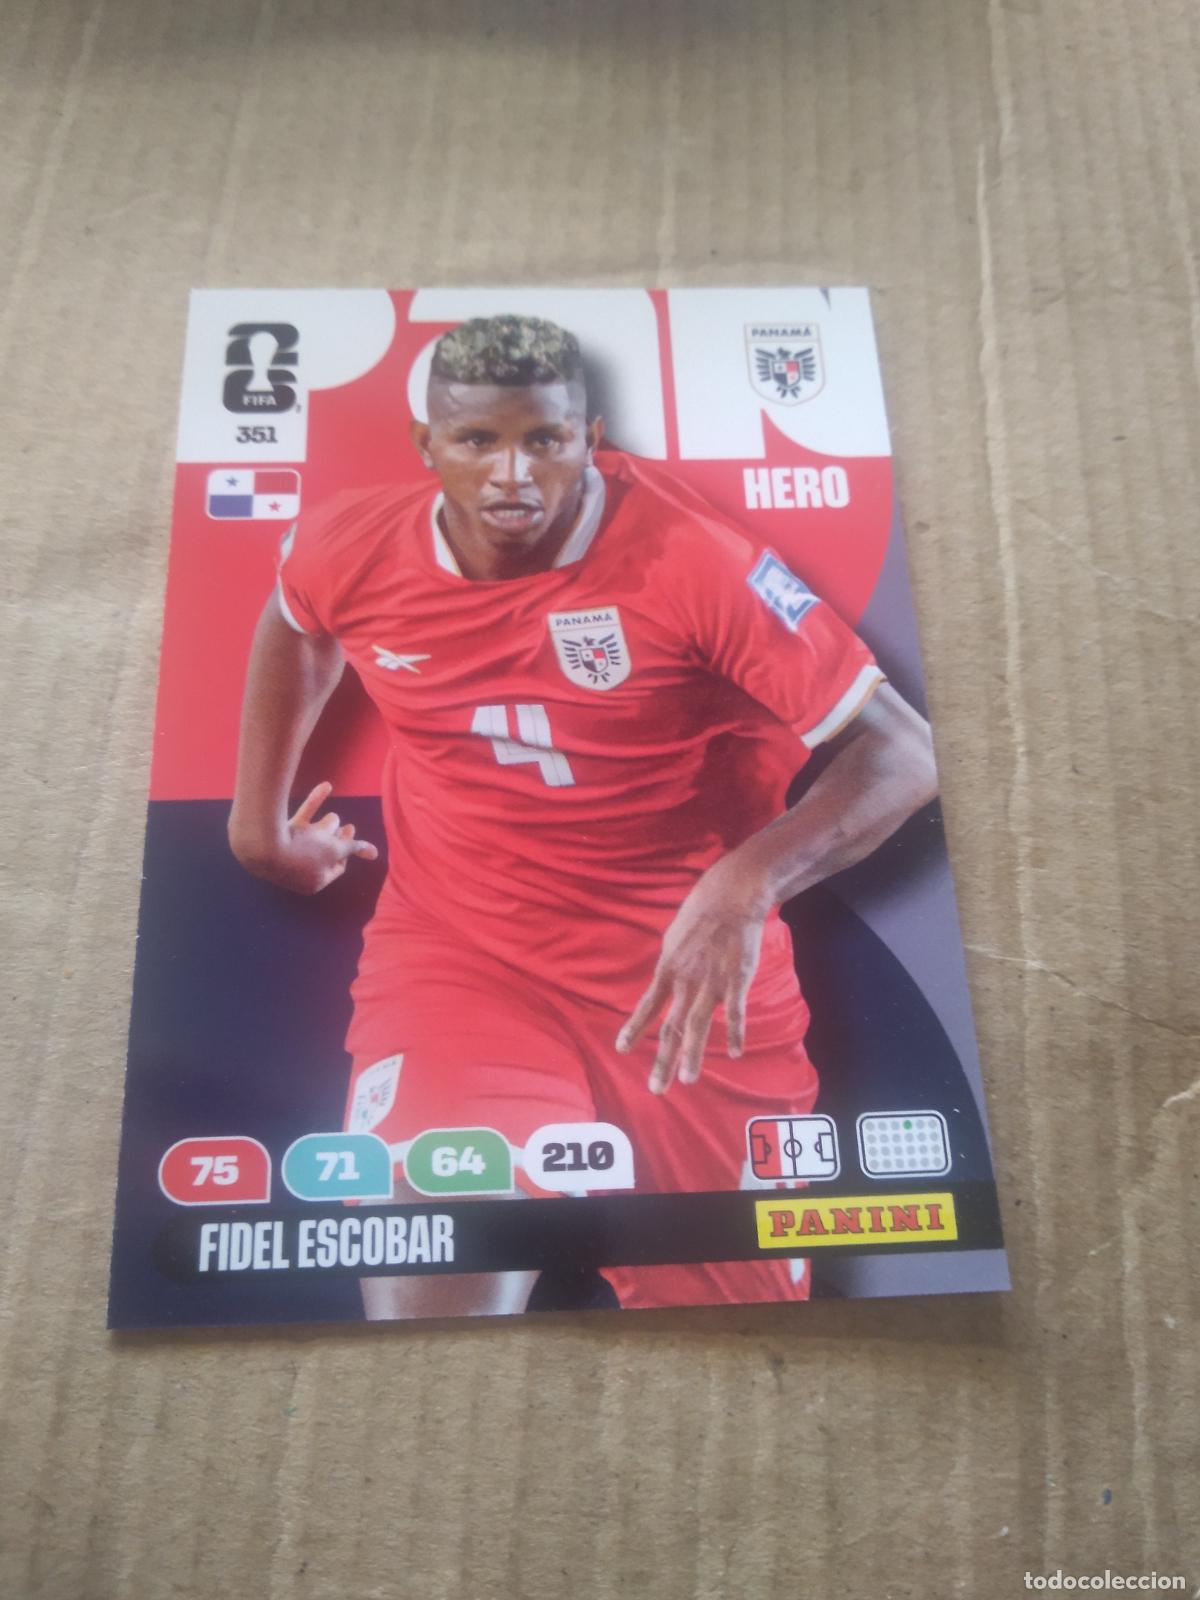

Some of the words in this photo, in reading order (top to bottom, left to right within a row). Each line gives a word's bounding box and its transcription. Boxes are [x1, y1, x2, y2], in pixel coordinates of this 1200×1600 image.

[242, 393, 277, 407] FIFA
[235, 426, 278, 445] 351
[742, 466, 850, 510] HERO
[470, 703, 577, 787] 4
[190, 1155, 240, 1186] 75
[315, 1150, 360, 1181] 71
[431, 1145, 487, 1177] 64
[541, 1140, 615, 1173] 210
[769, 1203, 945, 1238] PANINI
[198, 1220, 290, 1272] FIDEL
[298, 1214, 455, 1269] ESCOBAR
